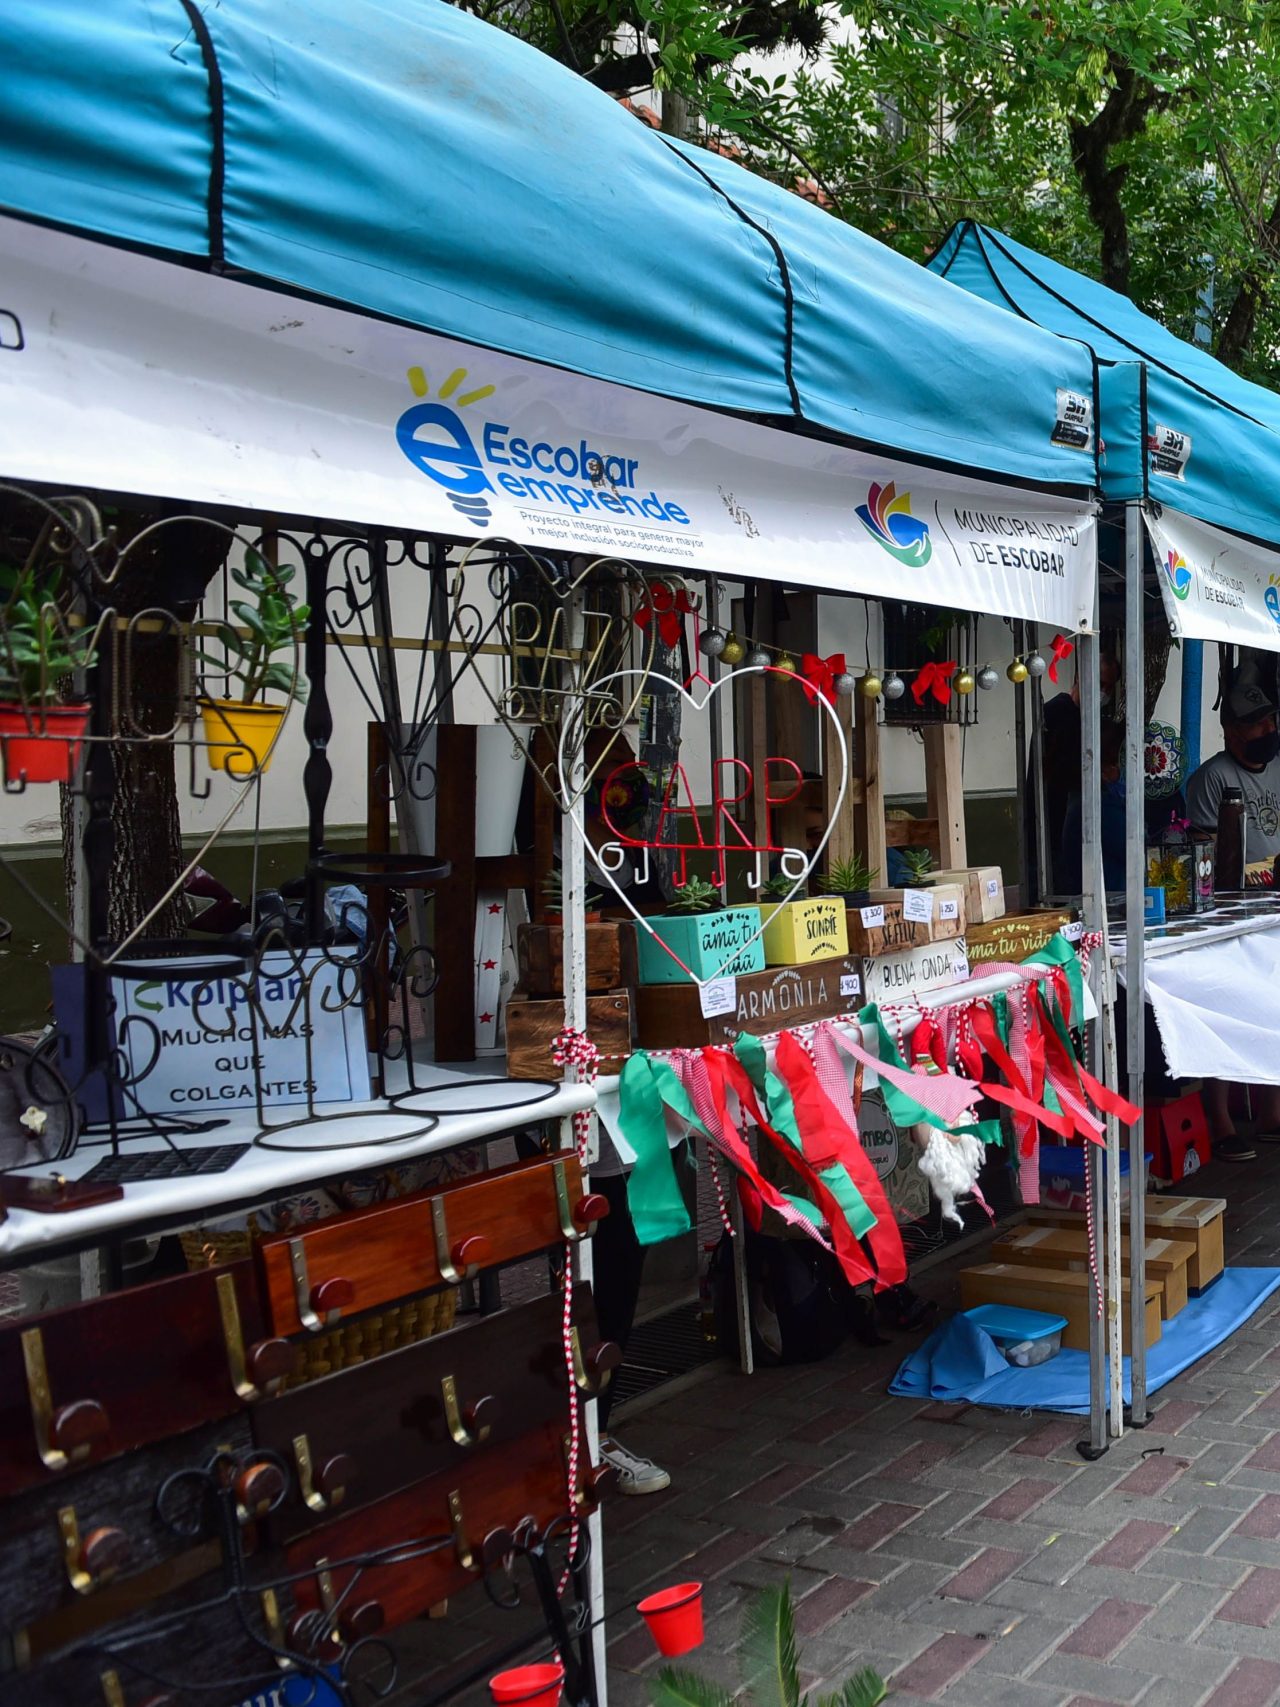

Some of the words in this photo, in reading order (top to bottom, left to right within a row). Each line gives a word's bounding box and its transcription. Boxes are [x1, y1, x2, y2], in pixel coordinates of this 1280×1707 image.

[1064, 412, 1084, 424] CARPAS
[483, 422, 639, 489] Escobar
[1160, 446, 1180, 458] CARPAS
[497, 472, 691, 525] emprende
[519, 510, 571, 528] Proyecto
[571, 518, 611, 534] integral
[613, 527, 637, 539] para
[637, 530, 674, 544] generar
[676, 537, 705, 550] mayor
[527, 526, 535, 536] y
[537, 526, 568, 541] mejor
[571, 532, 618, 547] inclusión
[618, 538, 695, 558] socioproductiva
[954, 508, 1079, 547] MUNICIPALIDAD
[969, 541, 997, 565] DE
[997, 545, 1065, 578] ESCOBAR
[1204, 586, 1215, 601] DE
[1215, 591, 1245, 613] ESCOBAR
[702, 930, 741, 951] ama
[893, 920, 916, 945] FELIZ
[998, 936, 1018, 955] tu
[882, 965, 915, 989] BUENA
[922, 953, 952, 981] ONDA
[165, 976, 308, 1012] Kolplan
[736, 978, 828, 1022] ARMONIA
[214, 1055, 266, 1073] QUE
[169, 1080, 318, 1103] COLGANTES
